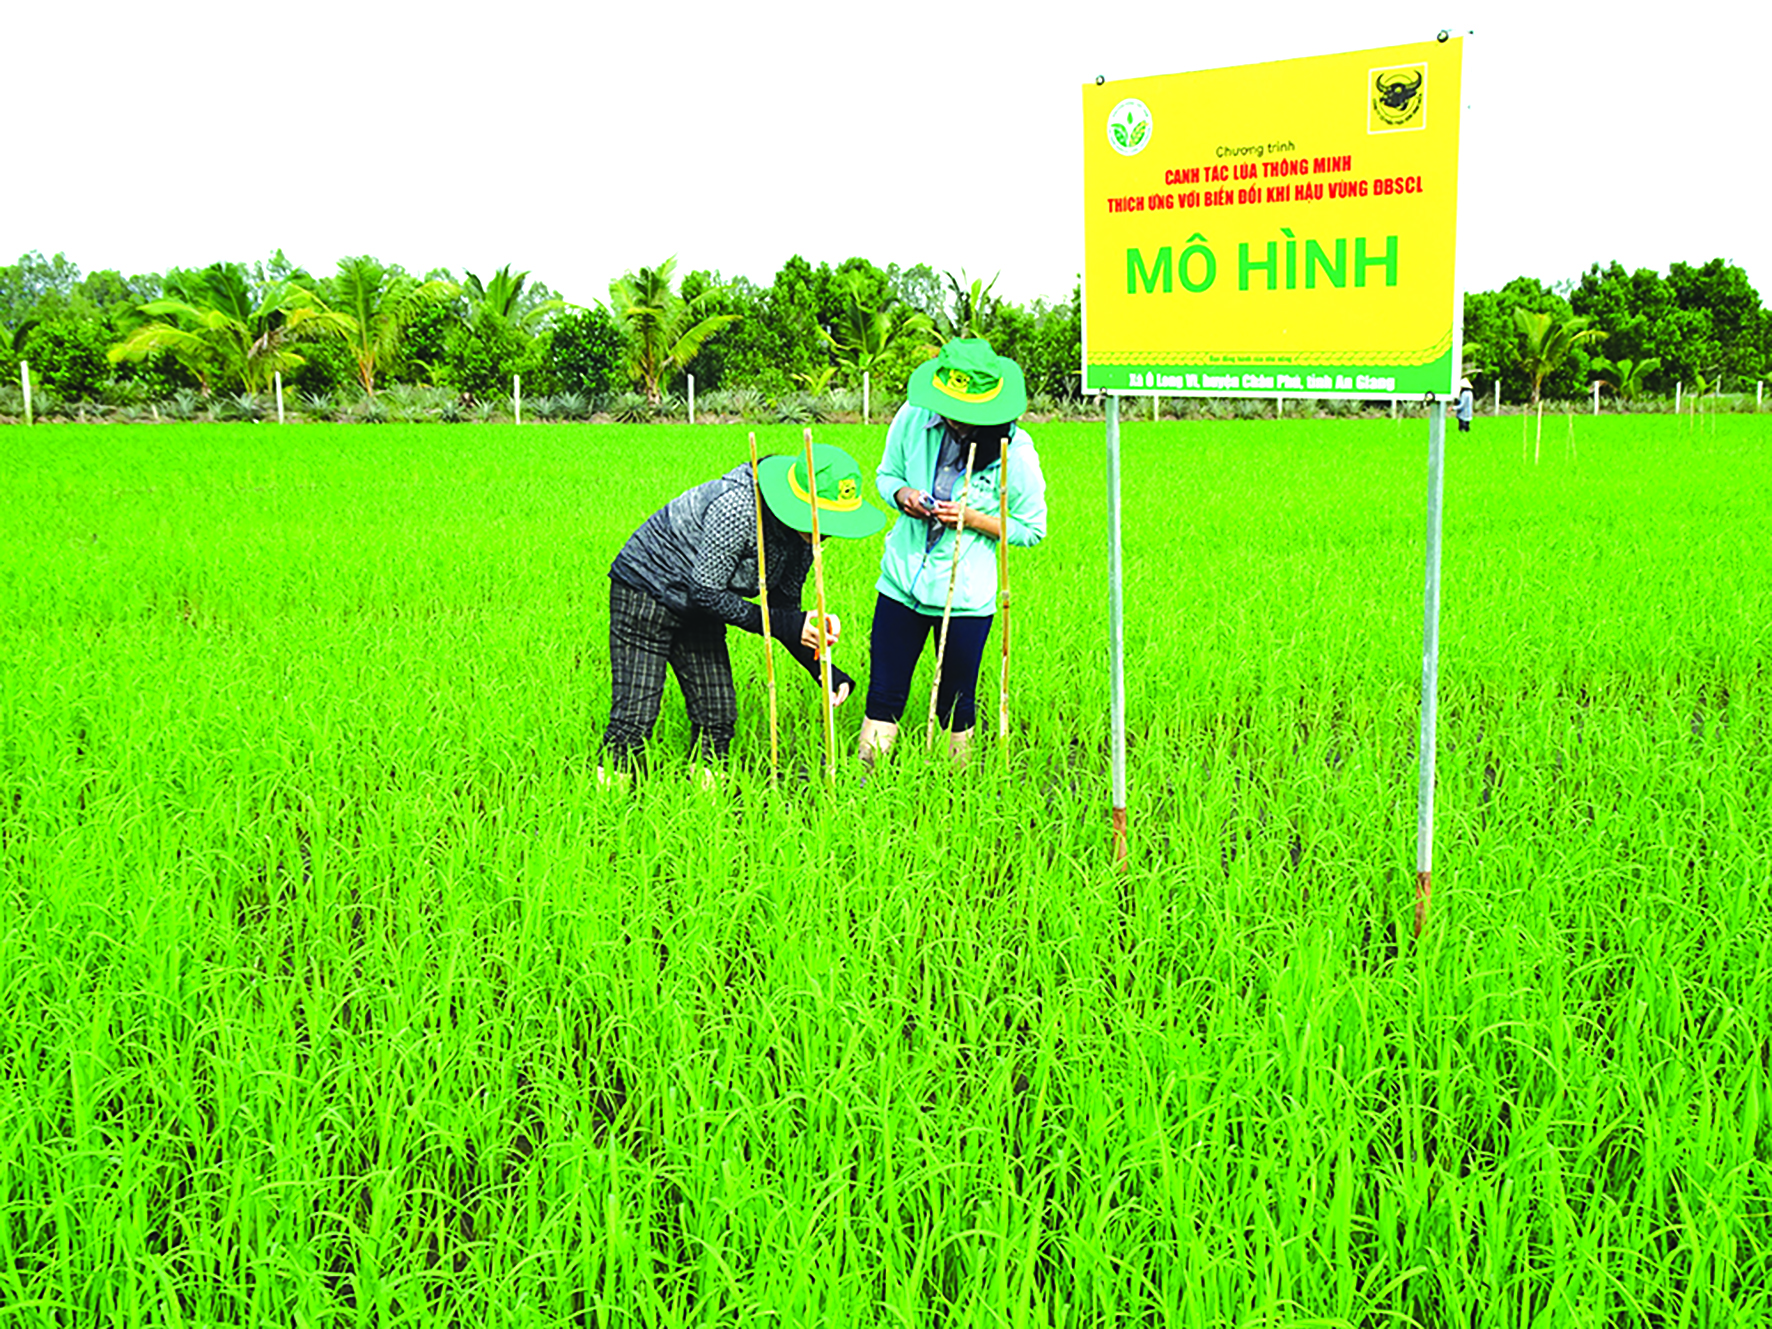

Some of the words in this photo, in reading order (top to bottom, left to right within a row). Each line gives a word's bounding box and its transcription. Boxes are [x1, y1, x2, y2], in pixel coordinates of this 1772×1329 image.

[1165, 168, 1200, 185] CANH
[1204, 165, 1229, 182] TÁC
[1262, 158, 1309, 178] THÔNG
[1313, 155, 1351, 174] MINH
[1204, 185, 1234, 207] BIẾN
[1266, 183, 1290, 203] KHÍ
[1295, 181, 1323, 204] HẬU
[1373, 176, 1423, 196] ĐBSCL
[1126, 232, 1217, 294] MÔ
[1238, 227, 1398, 291] HÌNH
[1156, 373, 1184, 389] Long
[1335, 375, 1353, 389] An
[1356, 374, 1395, 392] Giang
